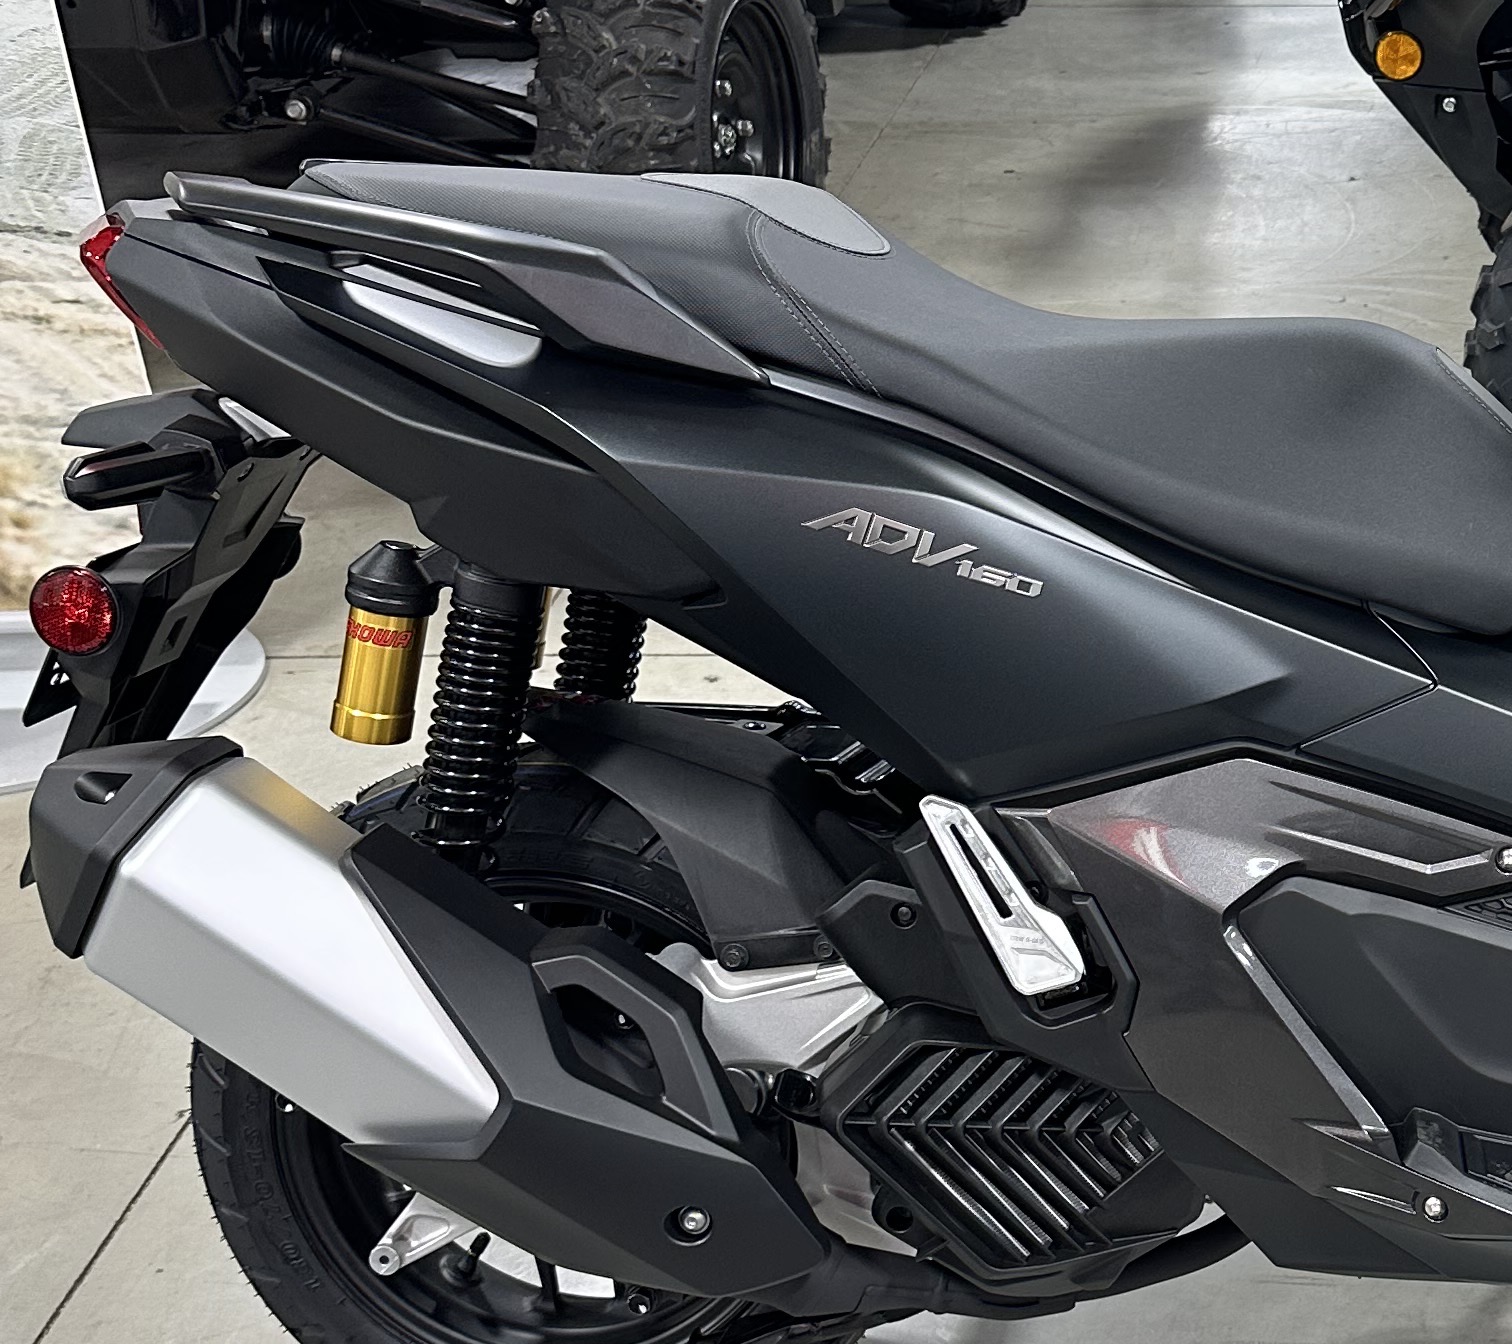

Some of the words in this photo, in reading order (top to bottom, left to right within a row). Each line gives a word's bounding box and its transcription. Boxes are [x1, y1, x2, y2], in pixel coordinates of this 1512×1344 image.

[800, 507, 979, 567] ADV
[955, 559, 1044, 598] 160
[346, 617, 414, 649] HOWA
